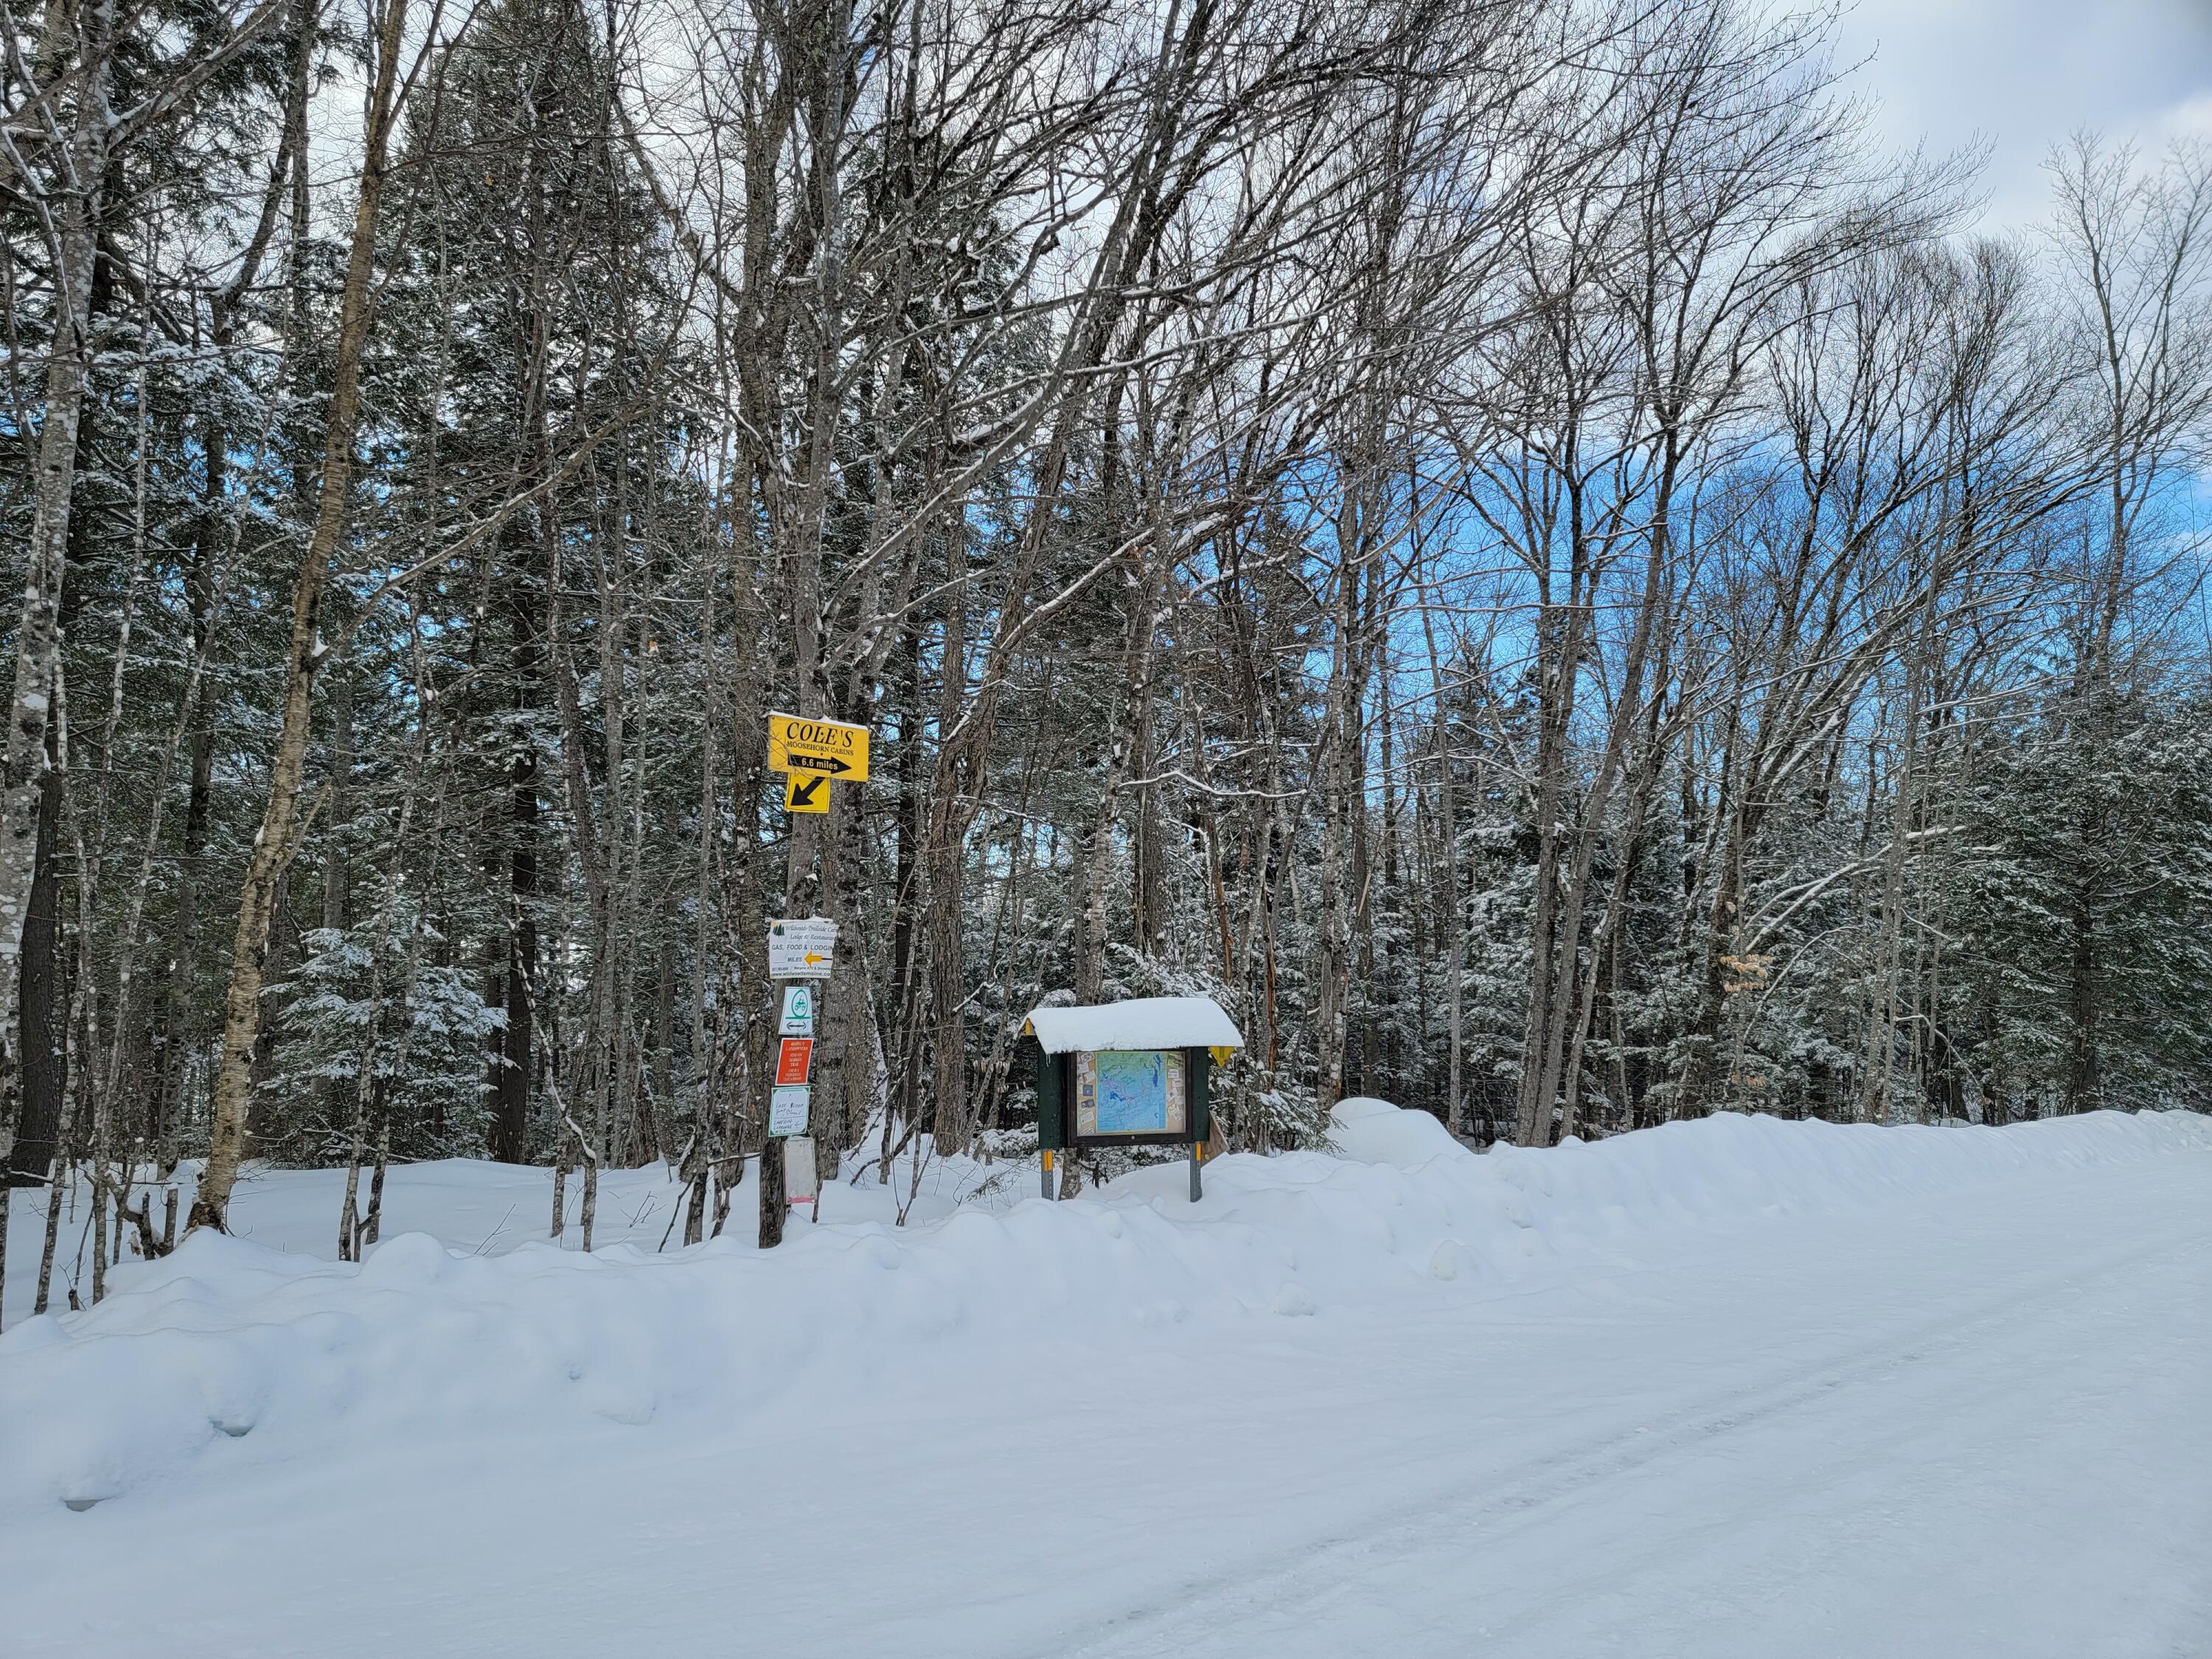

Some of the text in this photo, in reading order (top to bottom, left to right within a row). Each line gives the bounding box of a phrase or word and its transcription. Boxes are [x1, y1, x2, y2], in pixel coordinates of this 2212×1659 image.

[787, 722, 854, 748] COLE'S
[786, 740, 854, 756] MOOSEHORN CABINS
[801, 758, 838, 770] 6.6 miles
